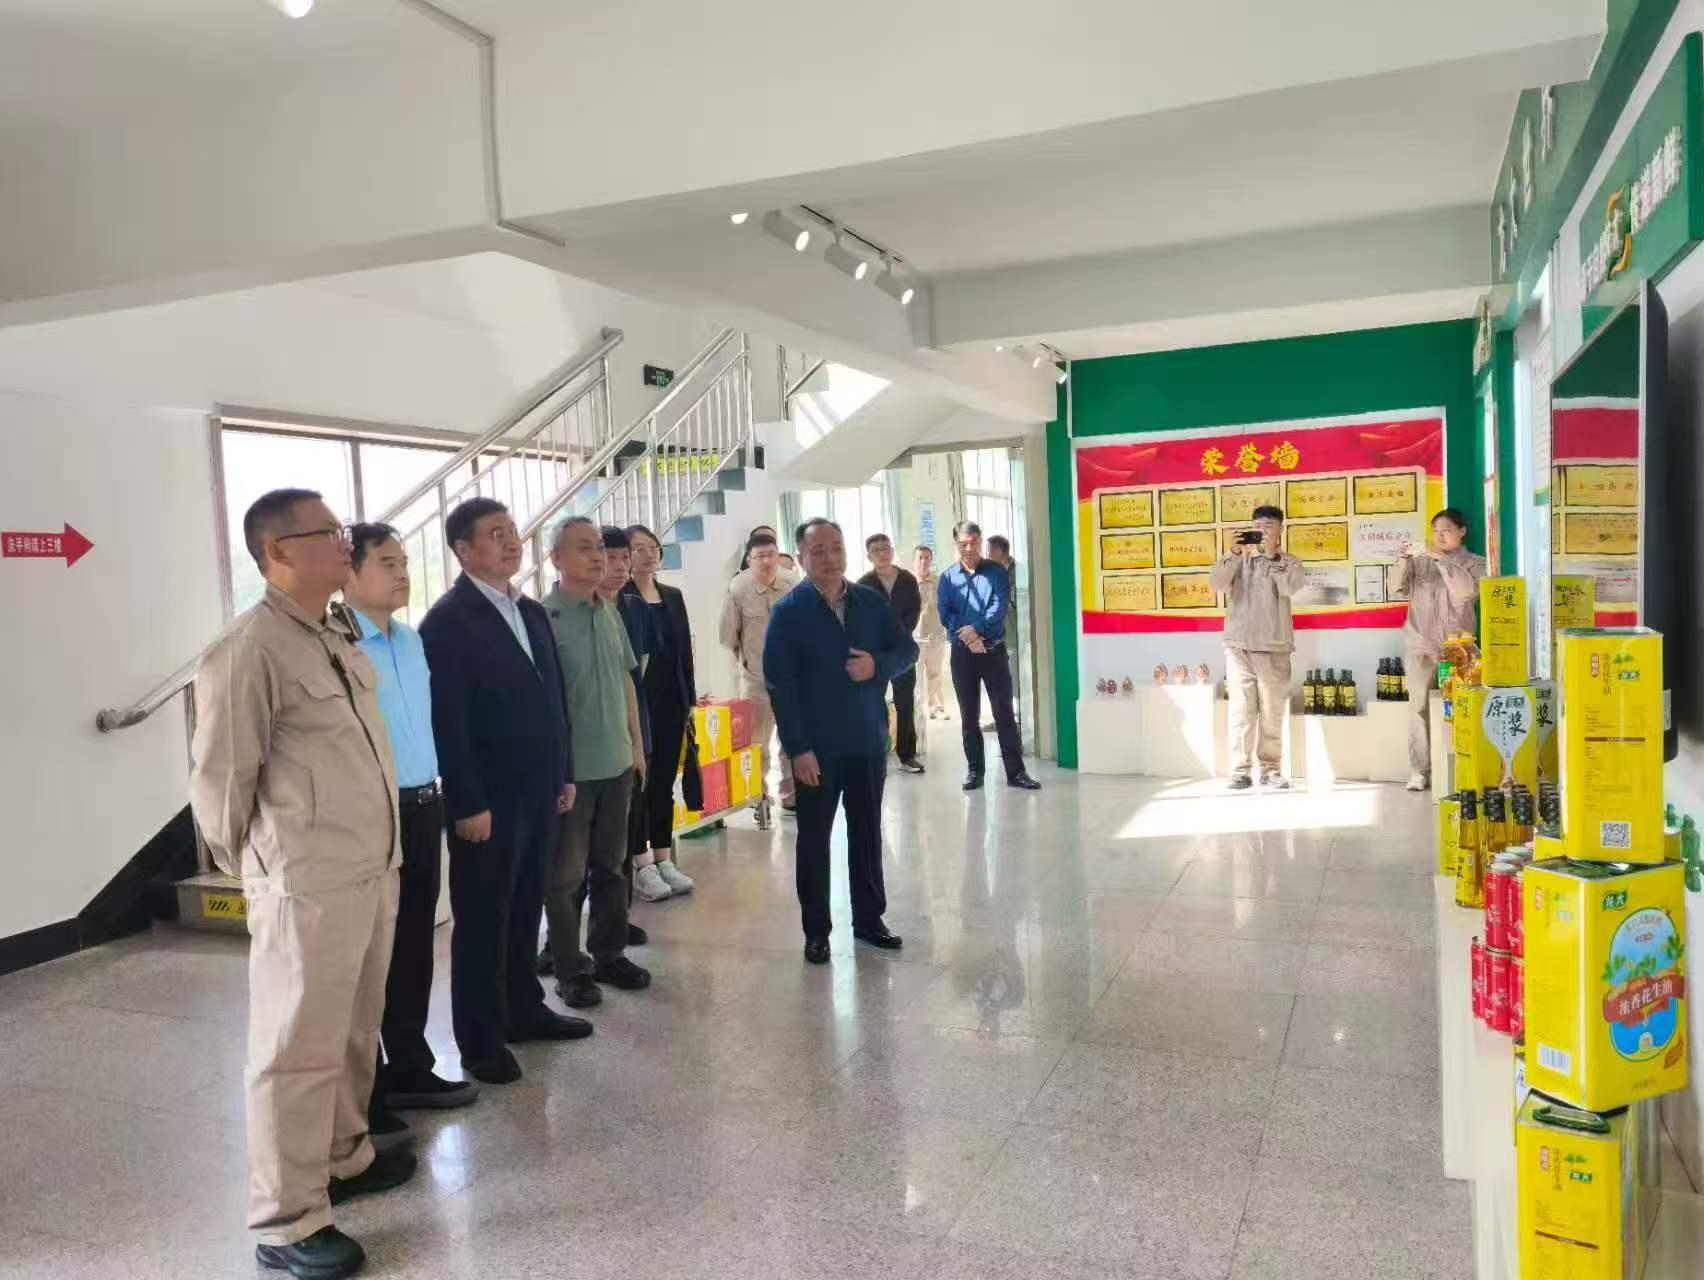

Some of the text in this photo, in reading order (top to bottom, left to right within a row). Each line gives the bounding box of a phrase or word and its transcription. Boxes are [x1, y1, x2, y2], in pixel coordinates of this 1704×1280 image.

[1200, 440, 1301, 476] 荣誉墙
[7, 536, 62, 553] 洗手间请上三楼
[1618, 977, 1673, 1017] 浓香花生油
